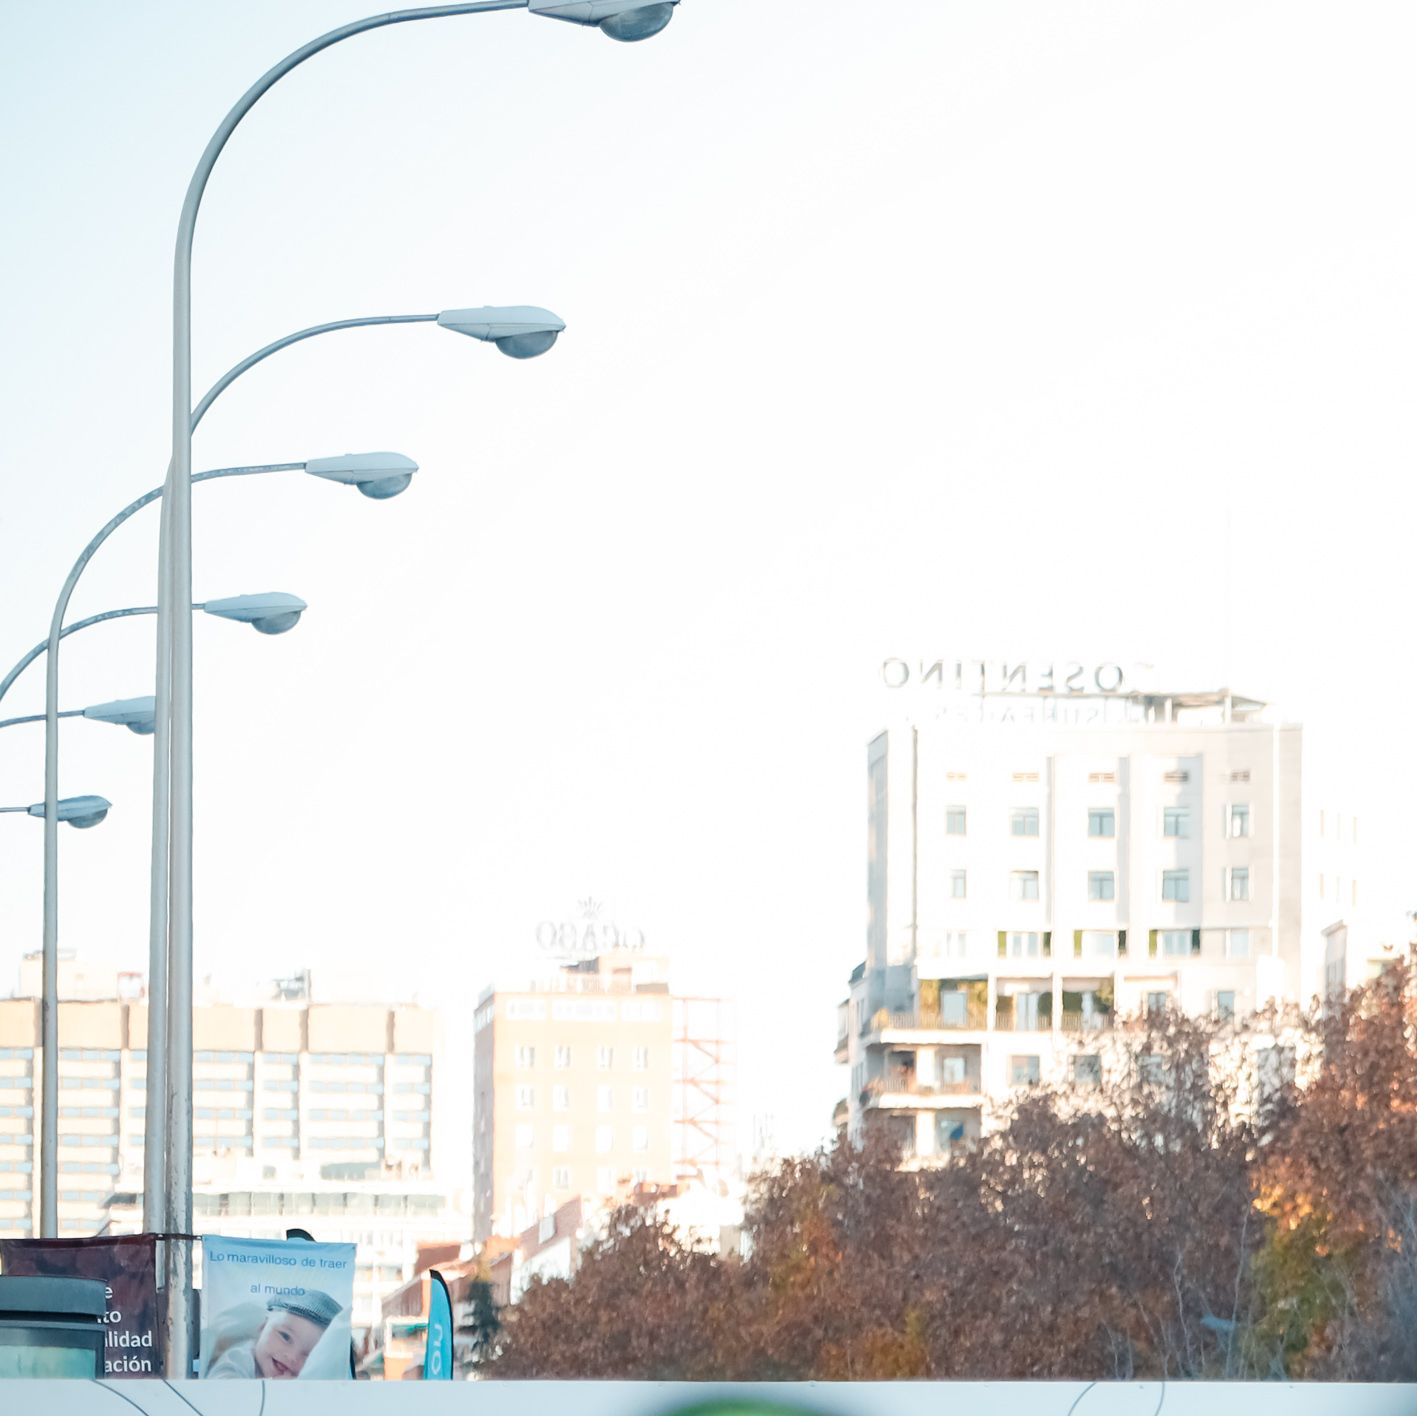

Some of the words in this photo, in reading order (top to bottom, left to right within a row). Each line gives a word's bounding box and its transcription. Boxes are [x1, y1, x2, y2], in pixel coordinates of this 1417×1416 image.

[209, 1251, 225, 1261] Lo
[227, 1253, 297, 1266] maravilloso
[301, 1257, 316, 1267] de
[320, 1258, 347, 1269] traer
[250, 1283, 261, 1293] al
[264, 1285, 305, 1296] mundo
[105, 1355, 152, 1372] ación
